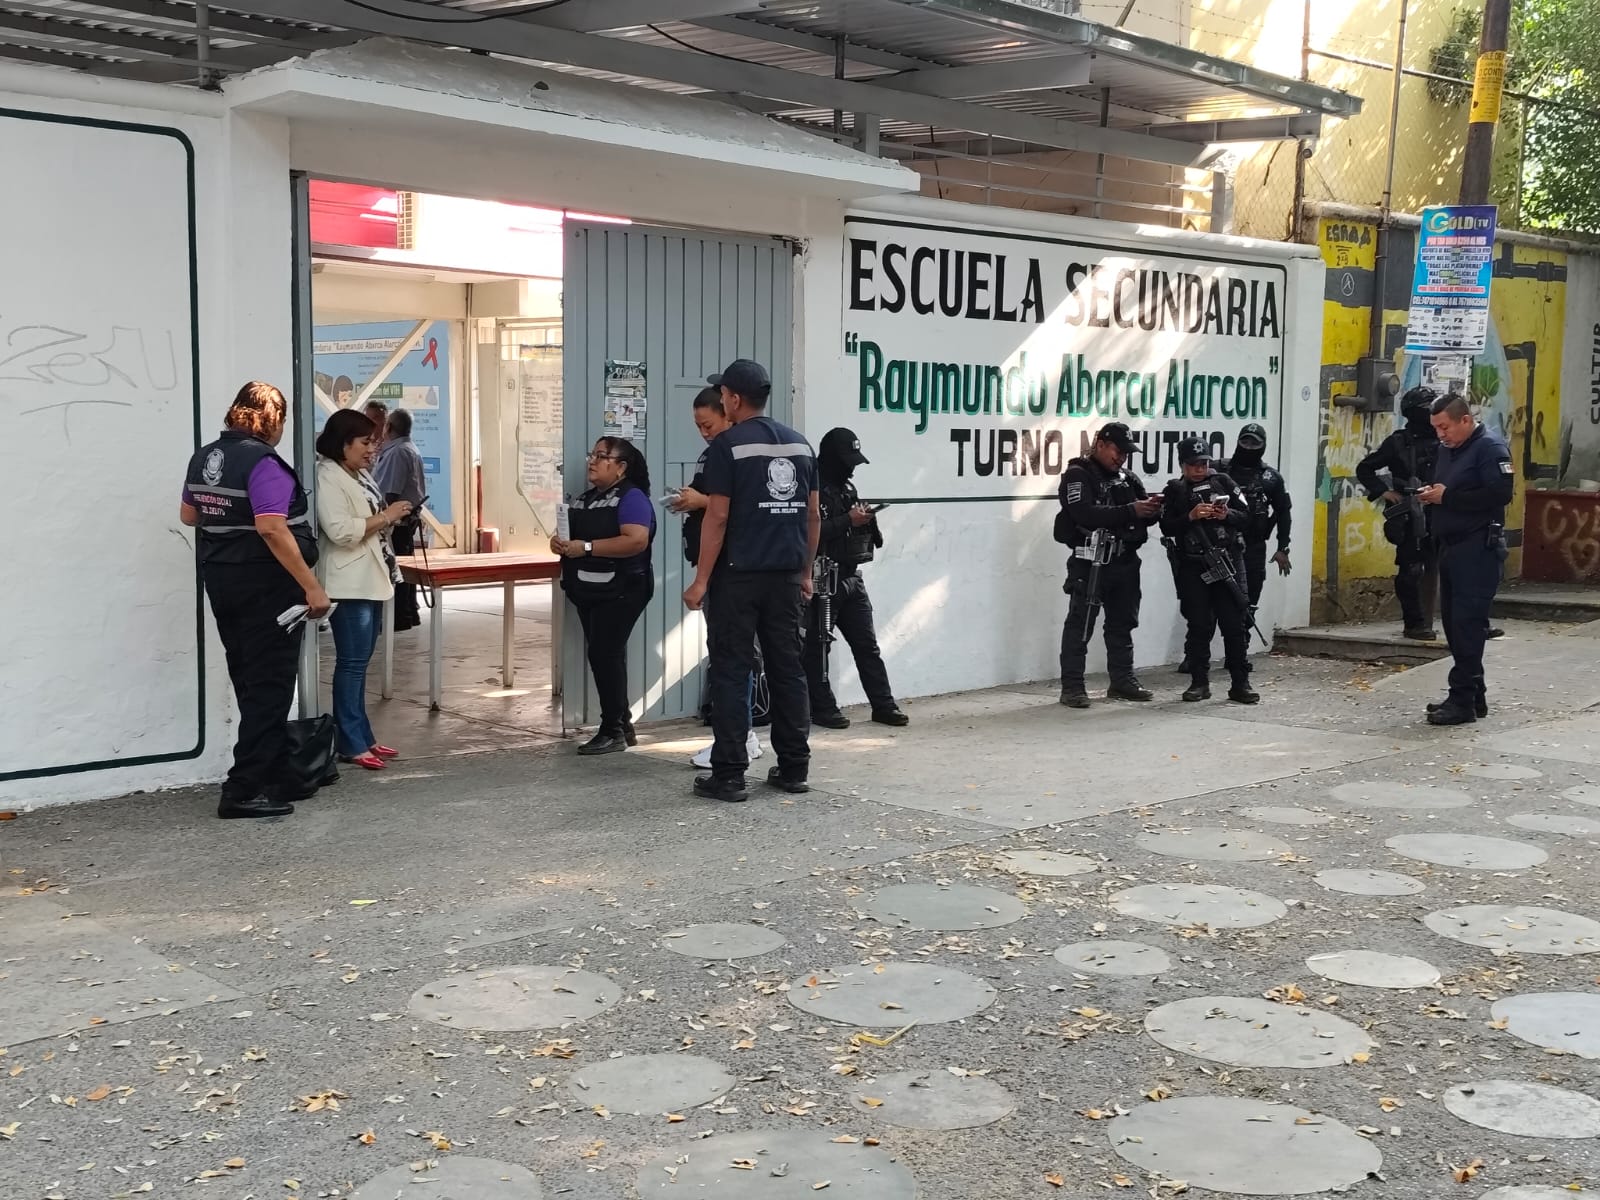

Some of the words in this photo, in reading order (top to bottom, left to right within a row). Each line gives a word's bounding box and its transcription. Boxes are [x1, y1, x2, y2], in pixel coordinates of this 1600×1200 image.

[1427, 212, 1474, 233] GOLD
[849, 238, 1045, 324] ESCUELA
[1064, 261, 1281, 340] SECUNDARIA
[1056, 353, 1157, 420] Abarca
[951, 428, 1063, 478] TURNO
